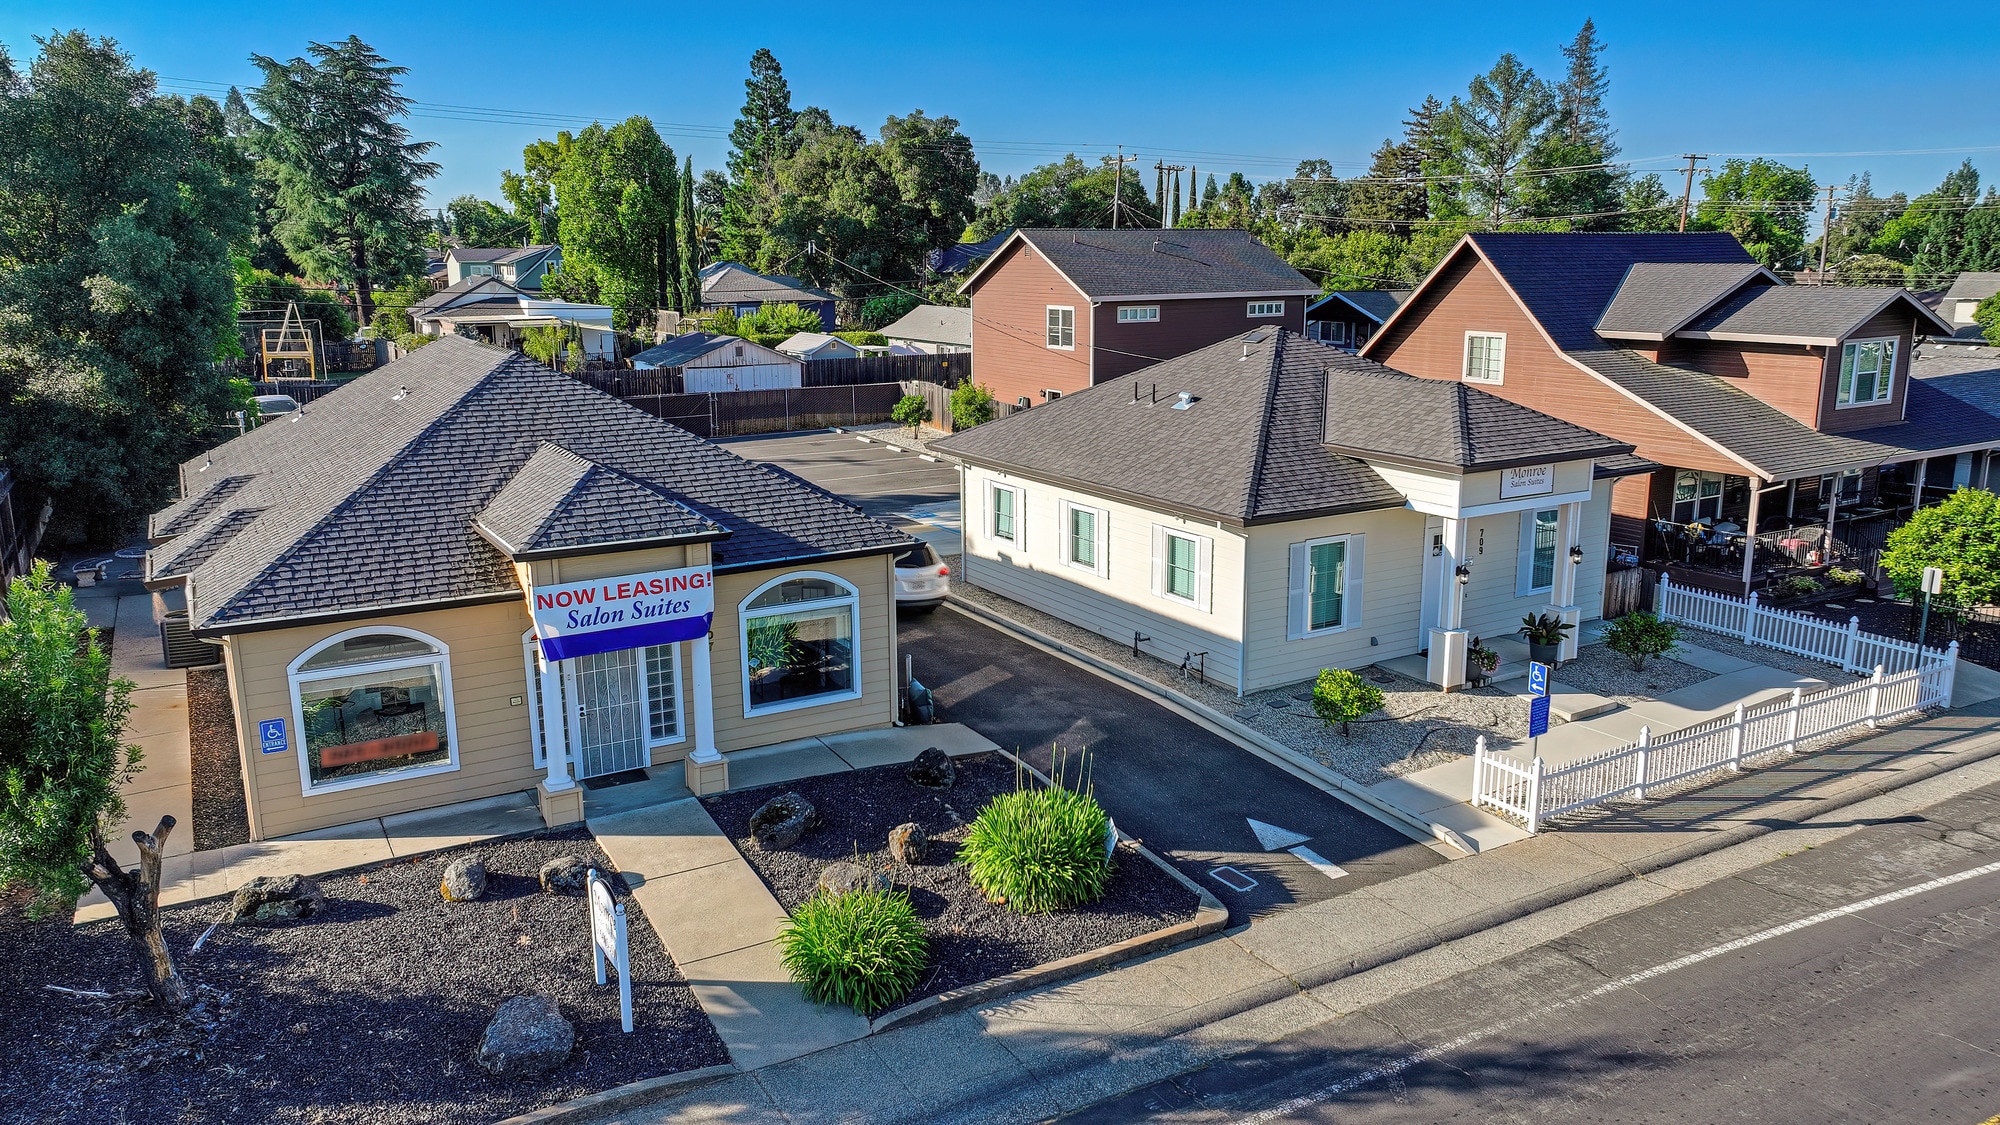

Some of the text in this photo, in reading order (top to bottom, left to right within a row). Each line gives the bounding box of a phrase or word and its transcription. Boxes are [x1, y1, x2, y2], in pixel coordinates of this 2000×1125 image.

[1510, 467, 1547, 479] Monroe
[1510, 478, 1545, 488] Salon Suites
[537, 572, 712, 610] NOW LEASING!
[566, 599, 691, 629] Salon Suites
